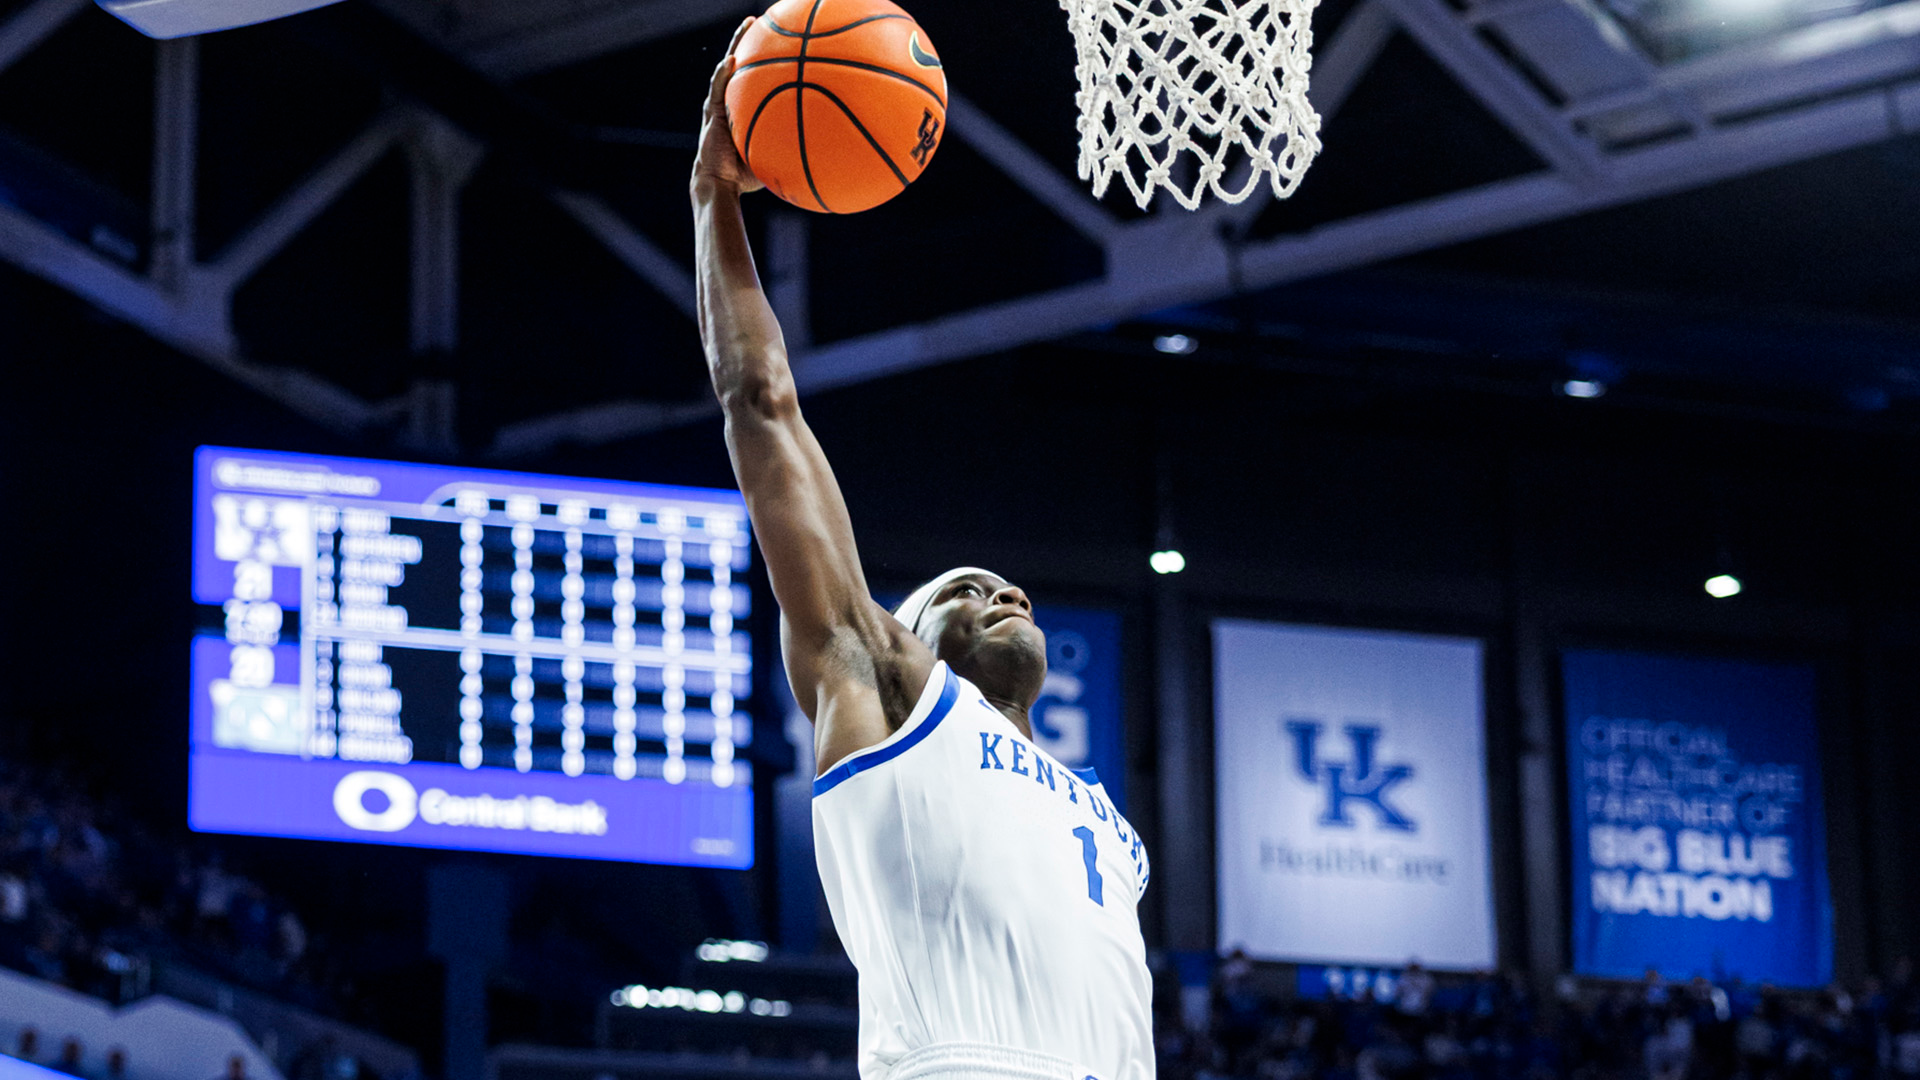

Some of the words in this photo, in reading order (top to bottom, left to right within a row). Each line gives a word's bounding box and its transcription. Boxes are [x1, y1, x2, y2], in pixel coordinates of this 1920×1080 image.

[910, 107, 940, 168] UK
[1283, 717, 1417, 833] UK
[420, 788, 527, 831] Central
[529, 795, 608, 837] Bank
[1072, 825, 1104, 907] 1
[1590, 826, 1669, 870] BIG
[1678, 828, 1793, 878] BLUE
[1592, 870, 1773, 921] NATION
